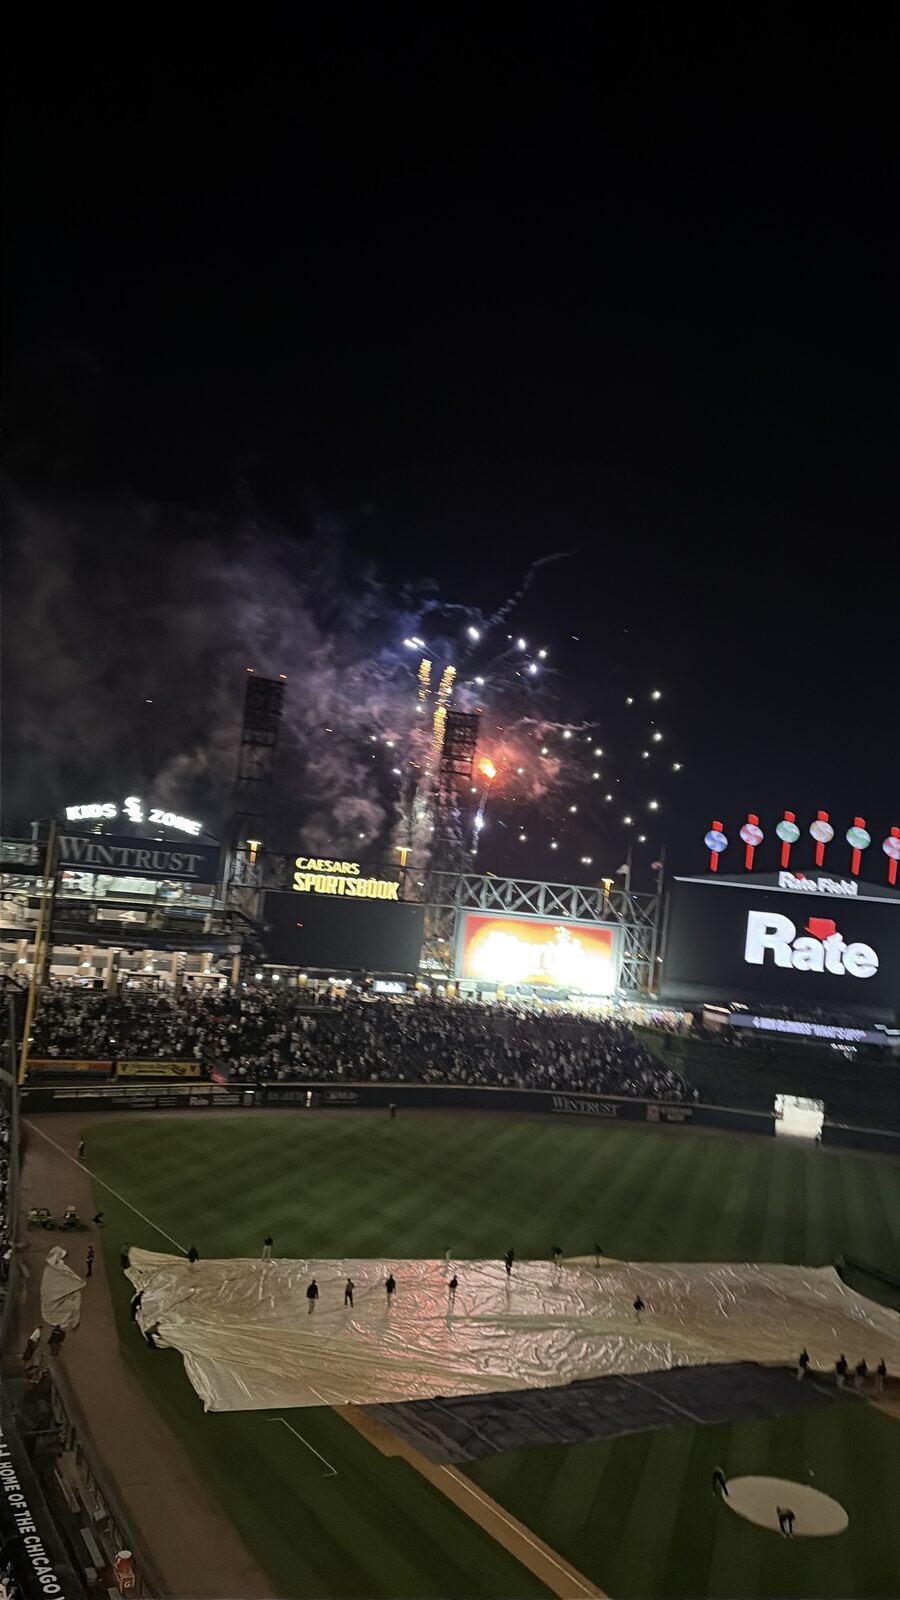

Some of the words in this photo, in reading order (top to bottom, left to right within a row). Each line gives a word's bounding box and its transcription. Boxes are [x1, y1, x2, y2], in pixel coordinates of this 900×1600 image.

[66, 803, 117, 820] KIDS
[149, 809, 202, 836] ZONE
[58, 836, 206, 873] WINTRUST
[296, 857, 360, 875] CAESARS
[293, 872, 399, 900] SPORTSBOOK
[779, 871, 817, 892] Rate
[818, 877, 858, 896] Field
[744, 910, 879, 978] Rate
[0, 1461, 21, 1492] HOME
[8, 1493, 27, 1509] OF
[14, 1510, 36, 1534] THE
[23, 1535, 61, 1594] CHICAGO
